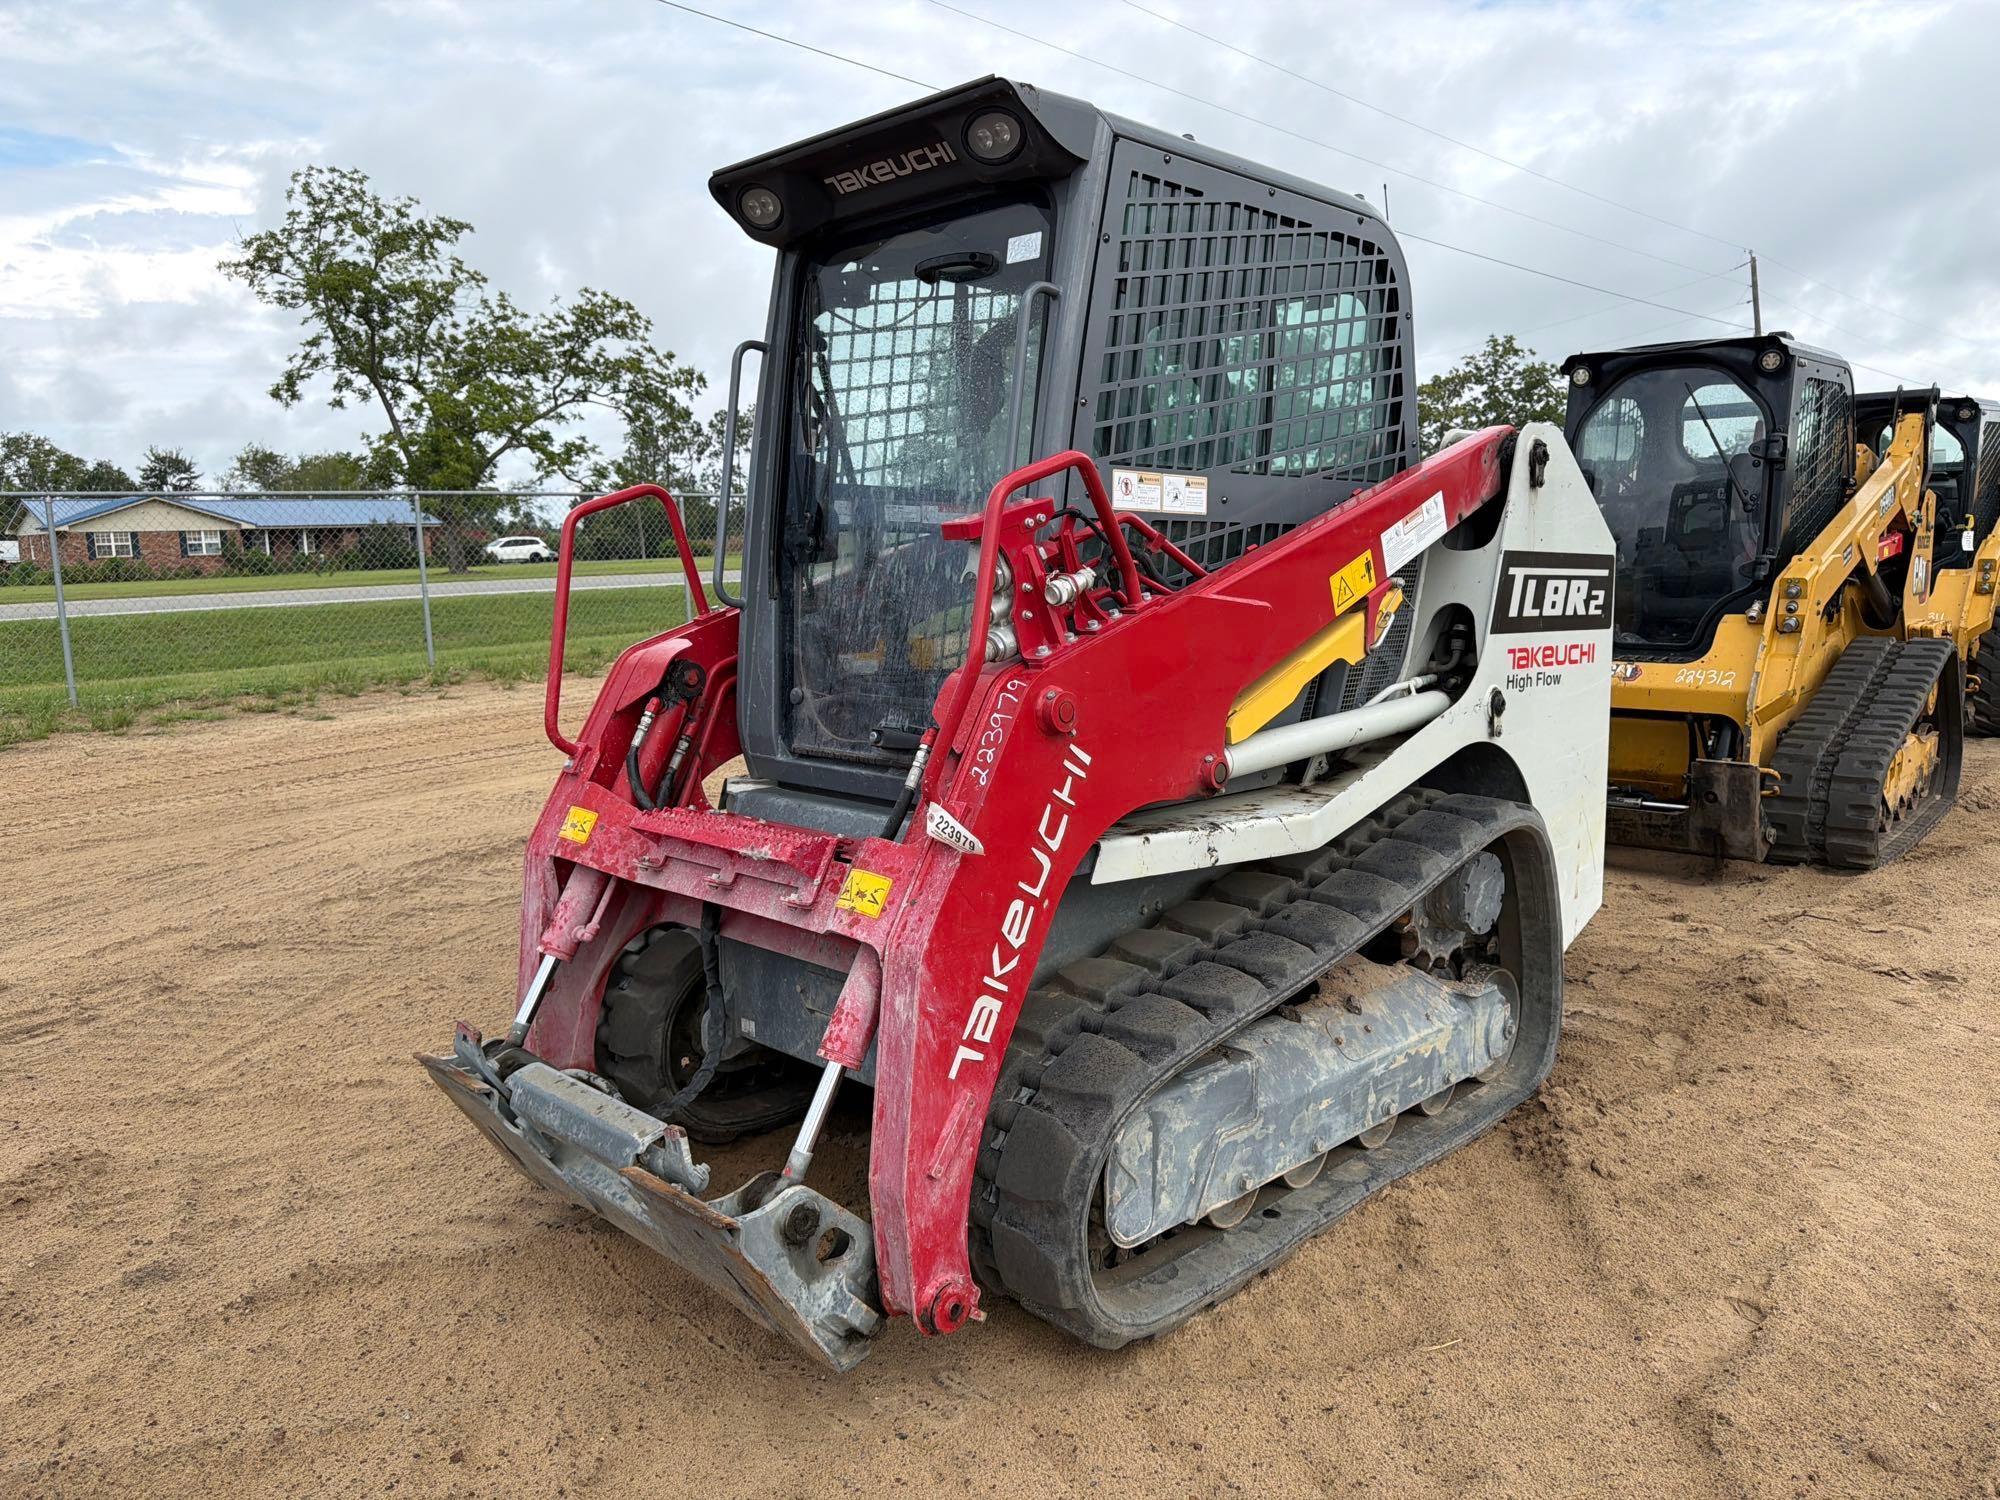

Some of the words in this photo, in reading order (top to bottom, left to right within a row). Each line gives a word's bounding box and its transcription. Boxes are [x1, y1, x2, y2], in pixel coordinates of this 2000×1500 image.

[823, 141, 957, 195] TAKEUCHI
[1507, 567, 1609, 617] TL8R2
[1507, 643, 1596, 670] TAKEUCHI
[1506, 673, 1533, 692] High
[1535, 671, 1562, 687] Flow
[1675, 668, 1736, 690] 224312
[971, 679, 1028, 785] 223979
[935, 815, 976, 851] 223979
[948, 743, 1092, 1080] TAKEUCHI
